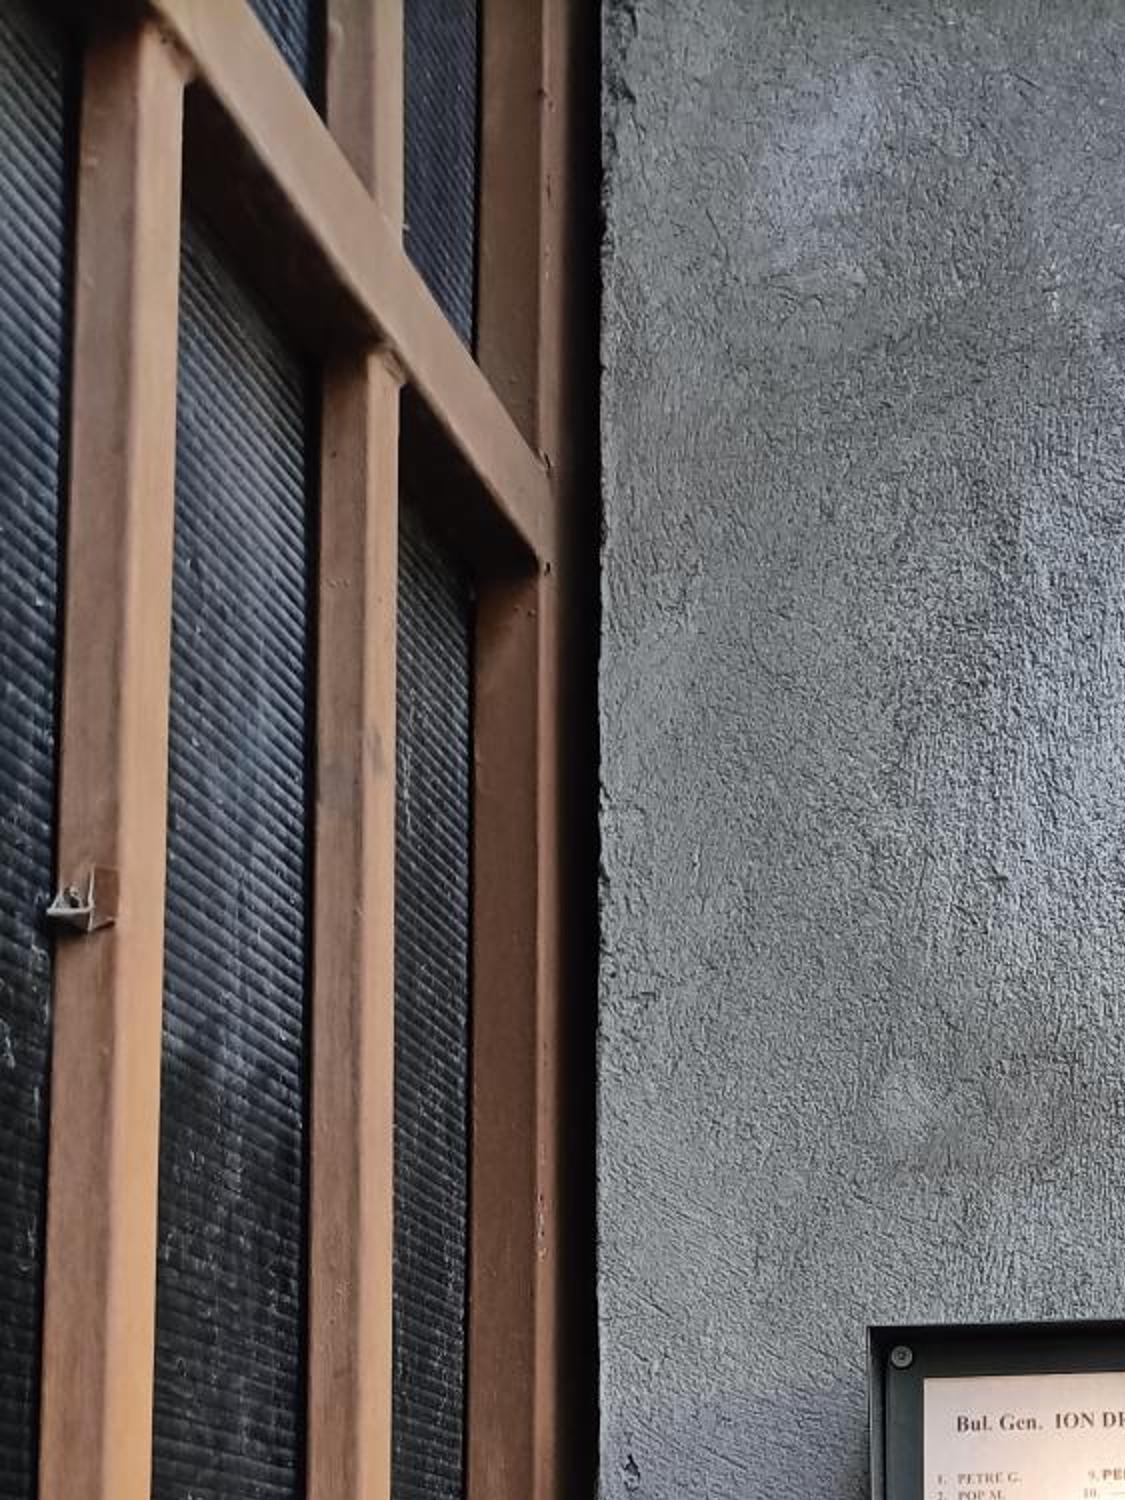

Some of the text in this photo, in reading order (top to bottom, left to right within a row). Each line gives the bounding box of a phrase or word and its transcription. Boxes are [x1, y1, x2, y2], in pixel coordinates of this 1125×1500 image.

[956, 1415, 992, 1433] Bul.
[1000, 1414, 1044, 1431] Gen.
[1055, 1413, 1101, 1429] ION
[957, 1473, 1004, 1485] PETRE
